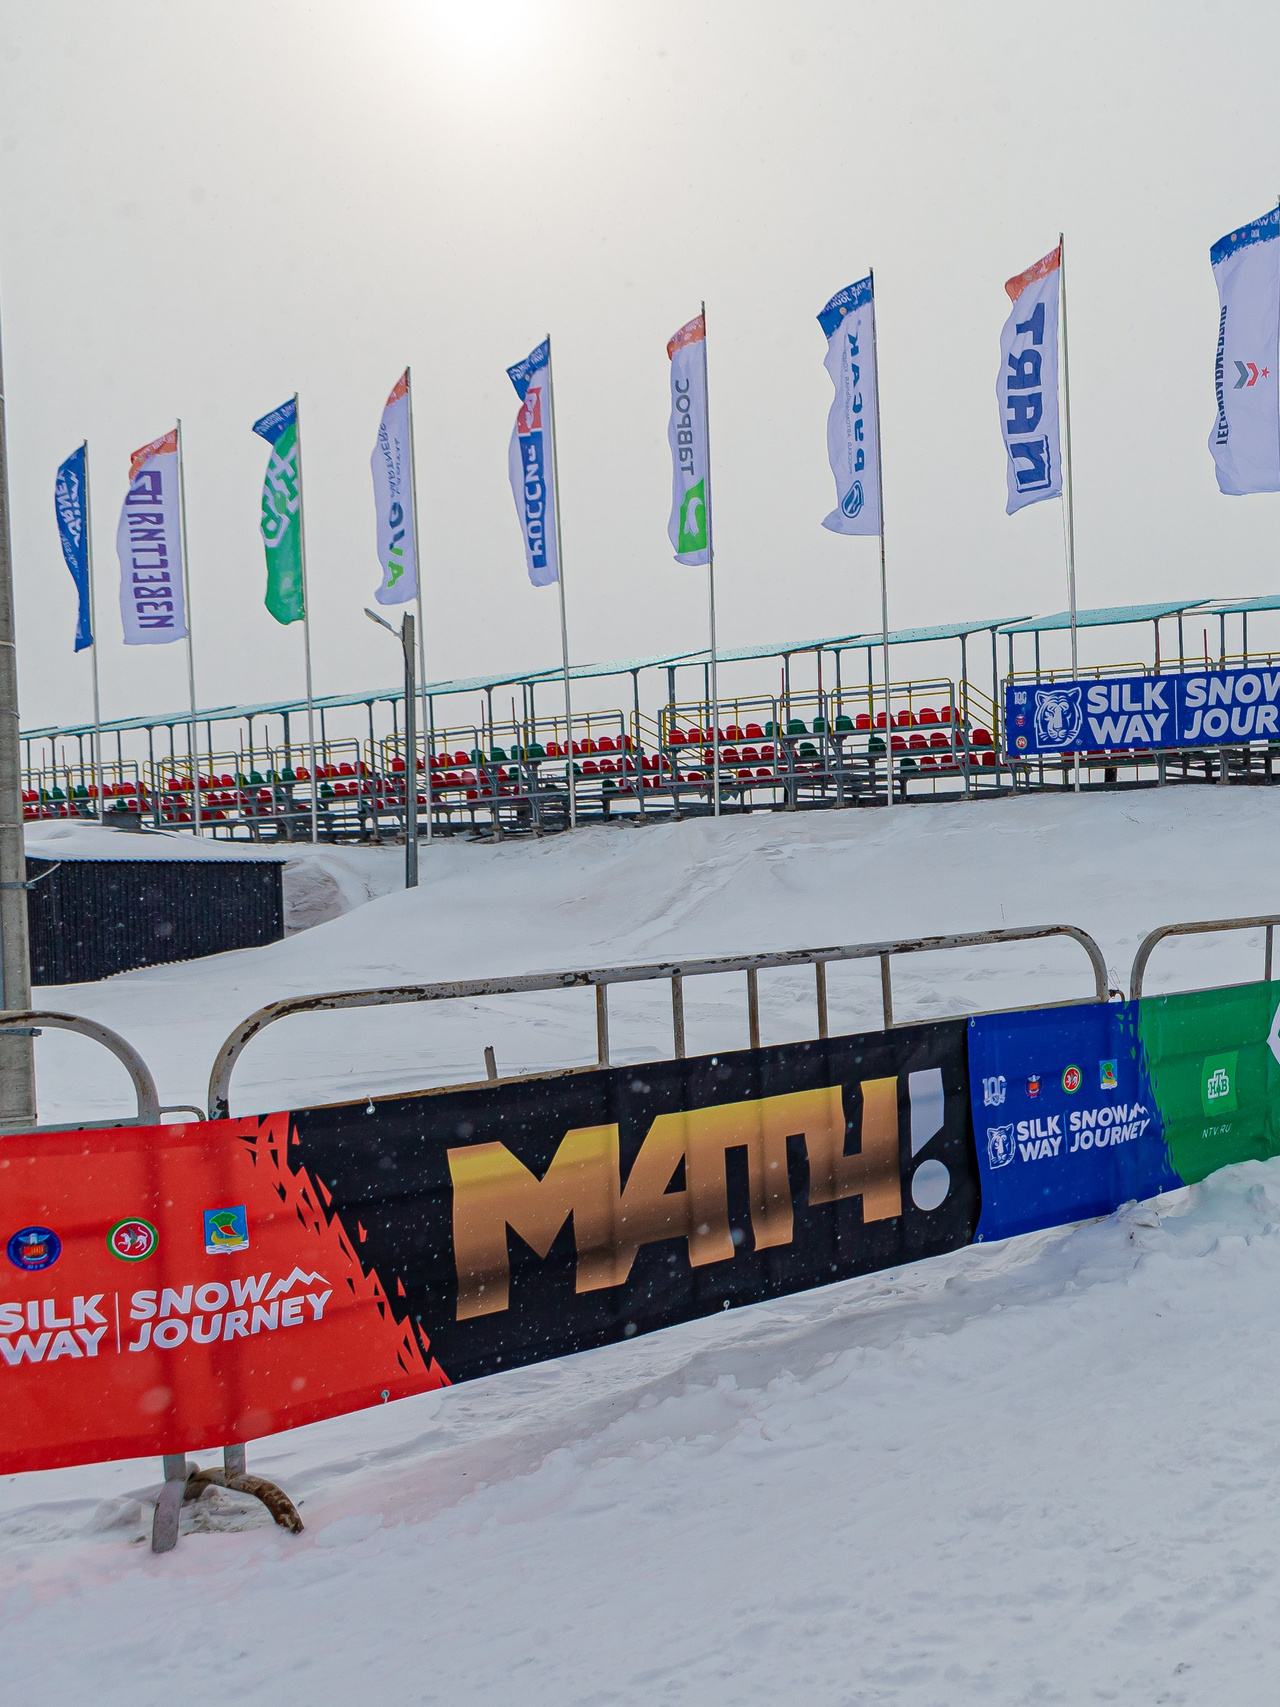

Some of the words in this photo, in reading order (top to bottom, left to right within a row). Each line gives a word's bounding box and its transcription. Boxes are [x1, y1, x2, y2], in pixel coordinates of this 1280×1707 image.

[1087, 680, 1168, 713] SILK
[1087, 713, 1170, 745] WAY
[1017, 1114, 1062, 1142] SILK
[1069, 1105, 1129, 1132] SNOW
[1018, 1137, 1062, 1162] WAY
[1069, 1118, 1150, 1153] JOURNEY
[1202, 1123, 1233, 1139] NTV.RU
[0, 1294, 108, 1334] SILK
[129, 1272, 272, 1320] SNOW
[0, 1325, 109, 1366] WAY
[128, 1290, 333, 1352] JOURNEY
